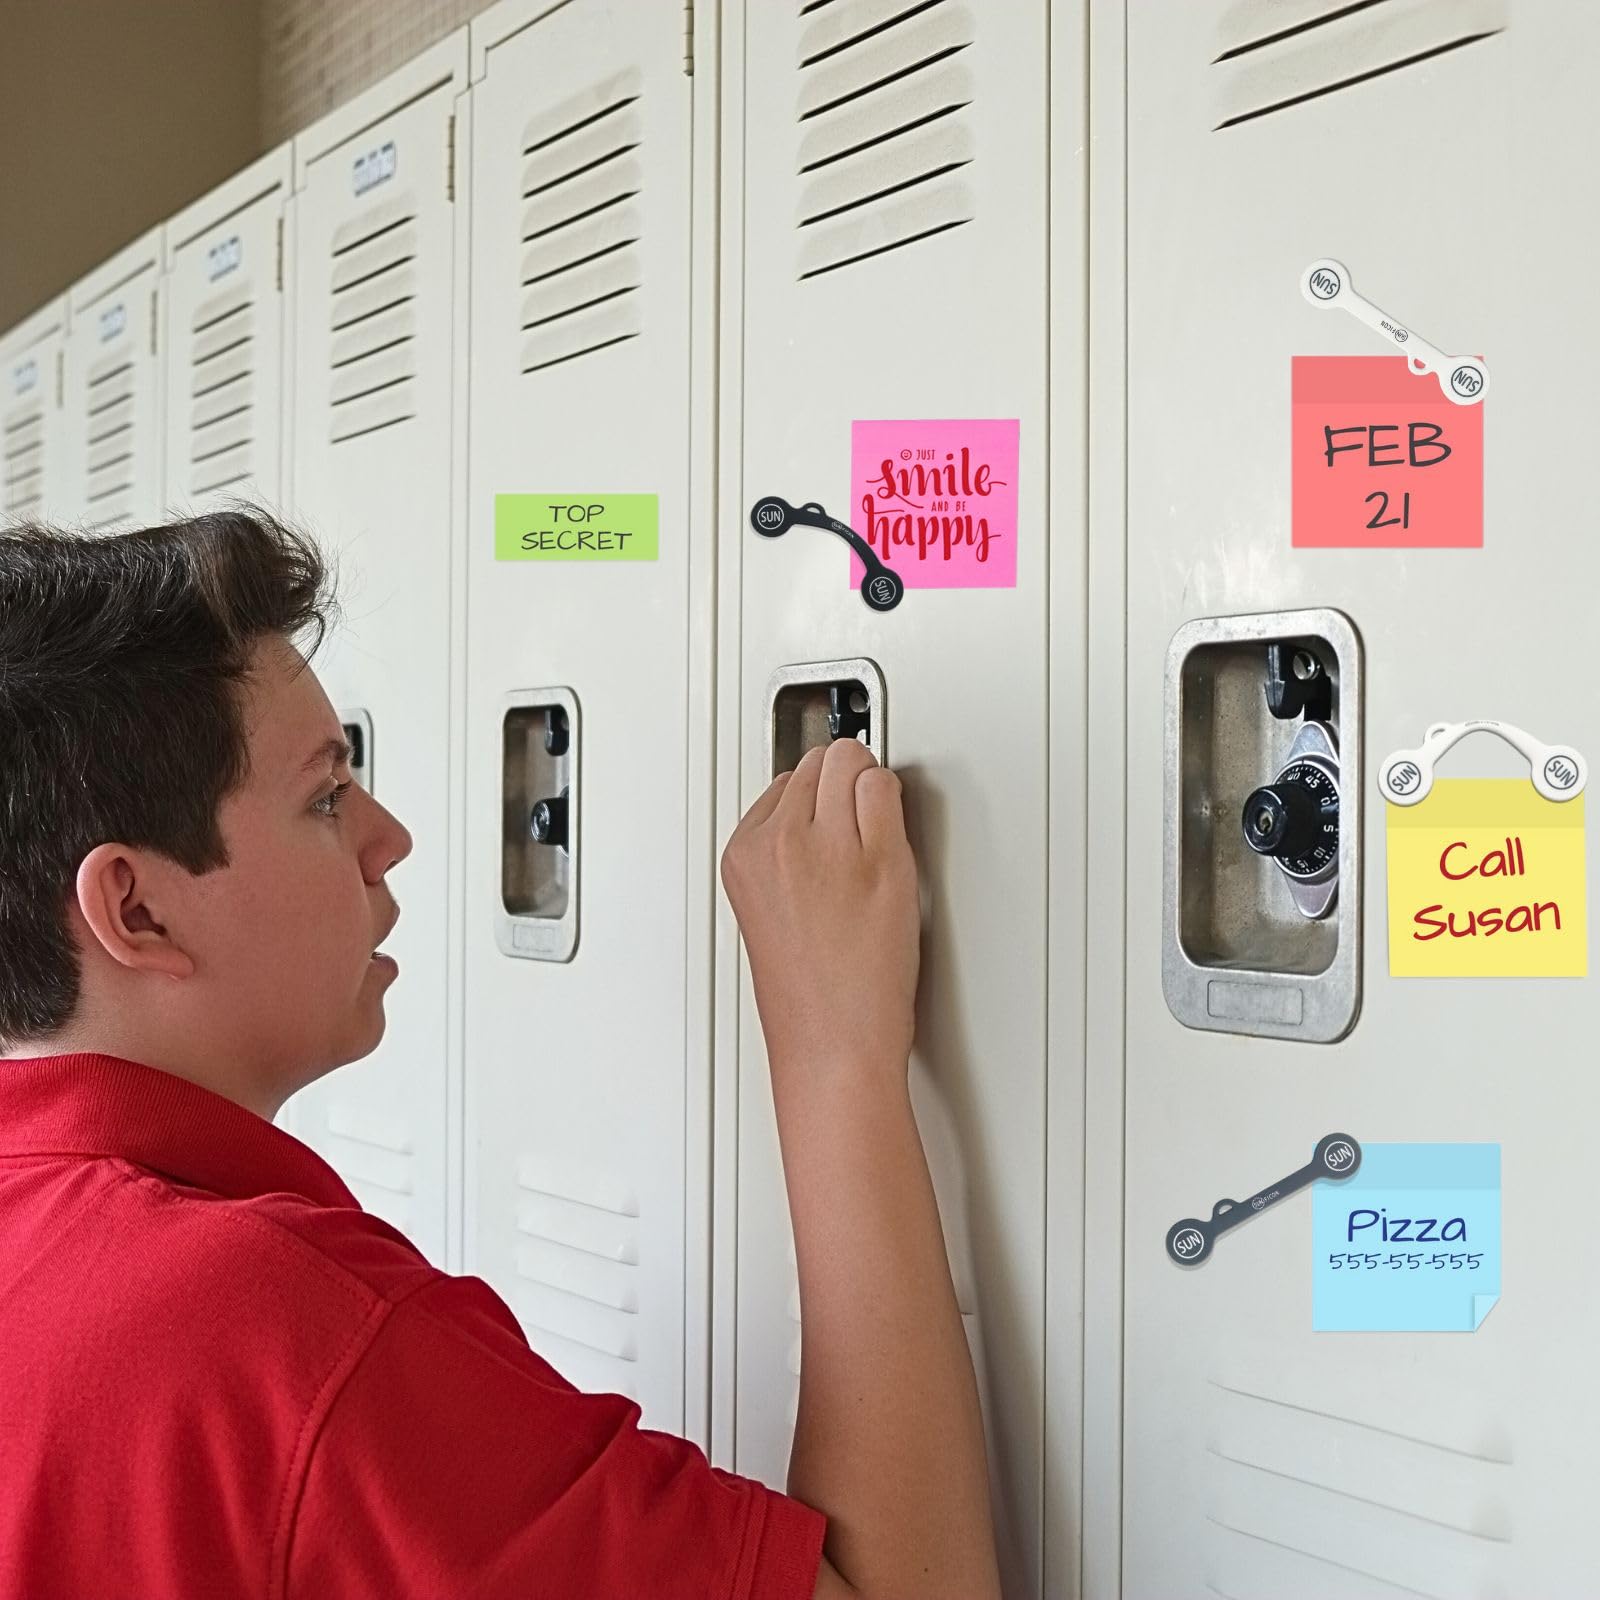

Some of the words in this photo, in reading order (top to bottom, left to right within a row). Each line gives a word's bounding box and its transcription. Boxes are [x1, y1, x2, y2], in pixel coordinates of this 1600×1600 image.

[1313, 273, 1337, 295] SUN
[1454, 370, 1480, 393] SUN
[916, 449, 935, 461] JUST
[1324, 422, 1452, 467] FEB
[866, 447, 1007, 508] smile
[548, 504, 605, 523] TOP
[760, 510, 781, 523] SUN
[931, 501, 949, 512] AND
[955, 501, 966, 512] BE
[1365, 491, 1410, 529] 21
[862, 493, 1001, 563] happy
[521, 530, 633, 550] SECRET
[874, 580, 891, 602] SUN
[1305, 775, 1320, 789] 45
[1392, 765, 1418, 791] SUN
[1548, 760, 1574, 786] SUN
[1323, 824, 1334, 833] 5
[1439, 836, 1525, 881] Call
[1413, 901, 1561, 941] Susan
[1328, 1145, 1352, 1167] SUN
[1347, 1208, 1467, 1242] Pizza
[1177, 1232, 1201, 1254] SUN
[1329, 1253, 1484, 1270] 555-55-555
